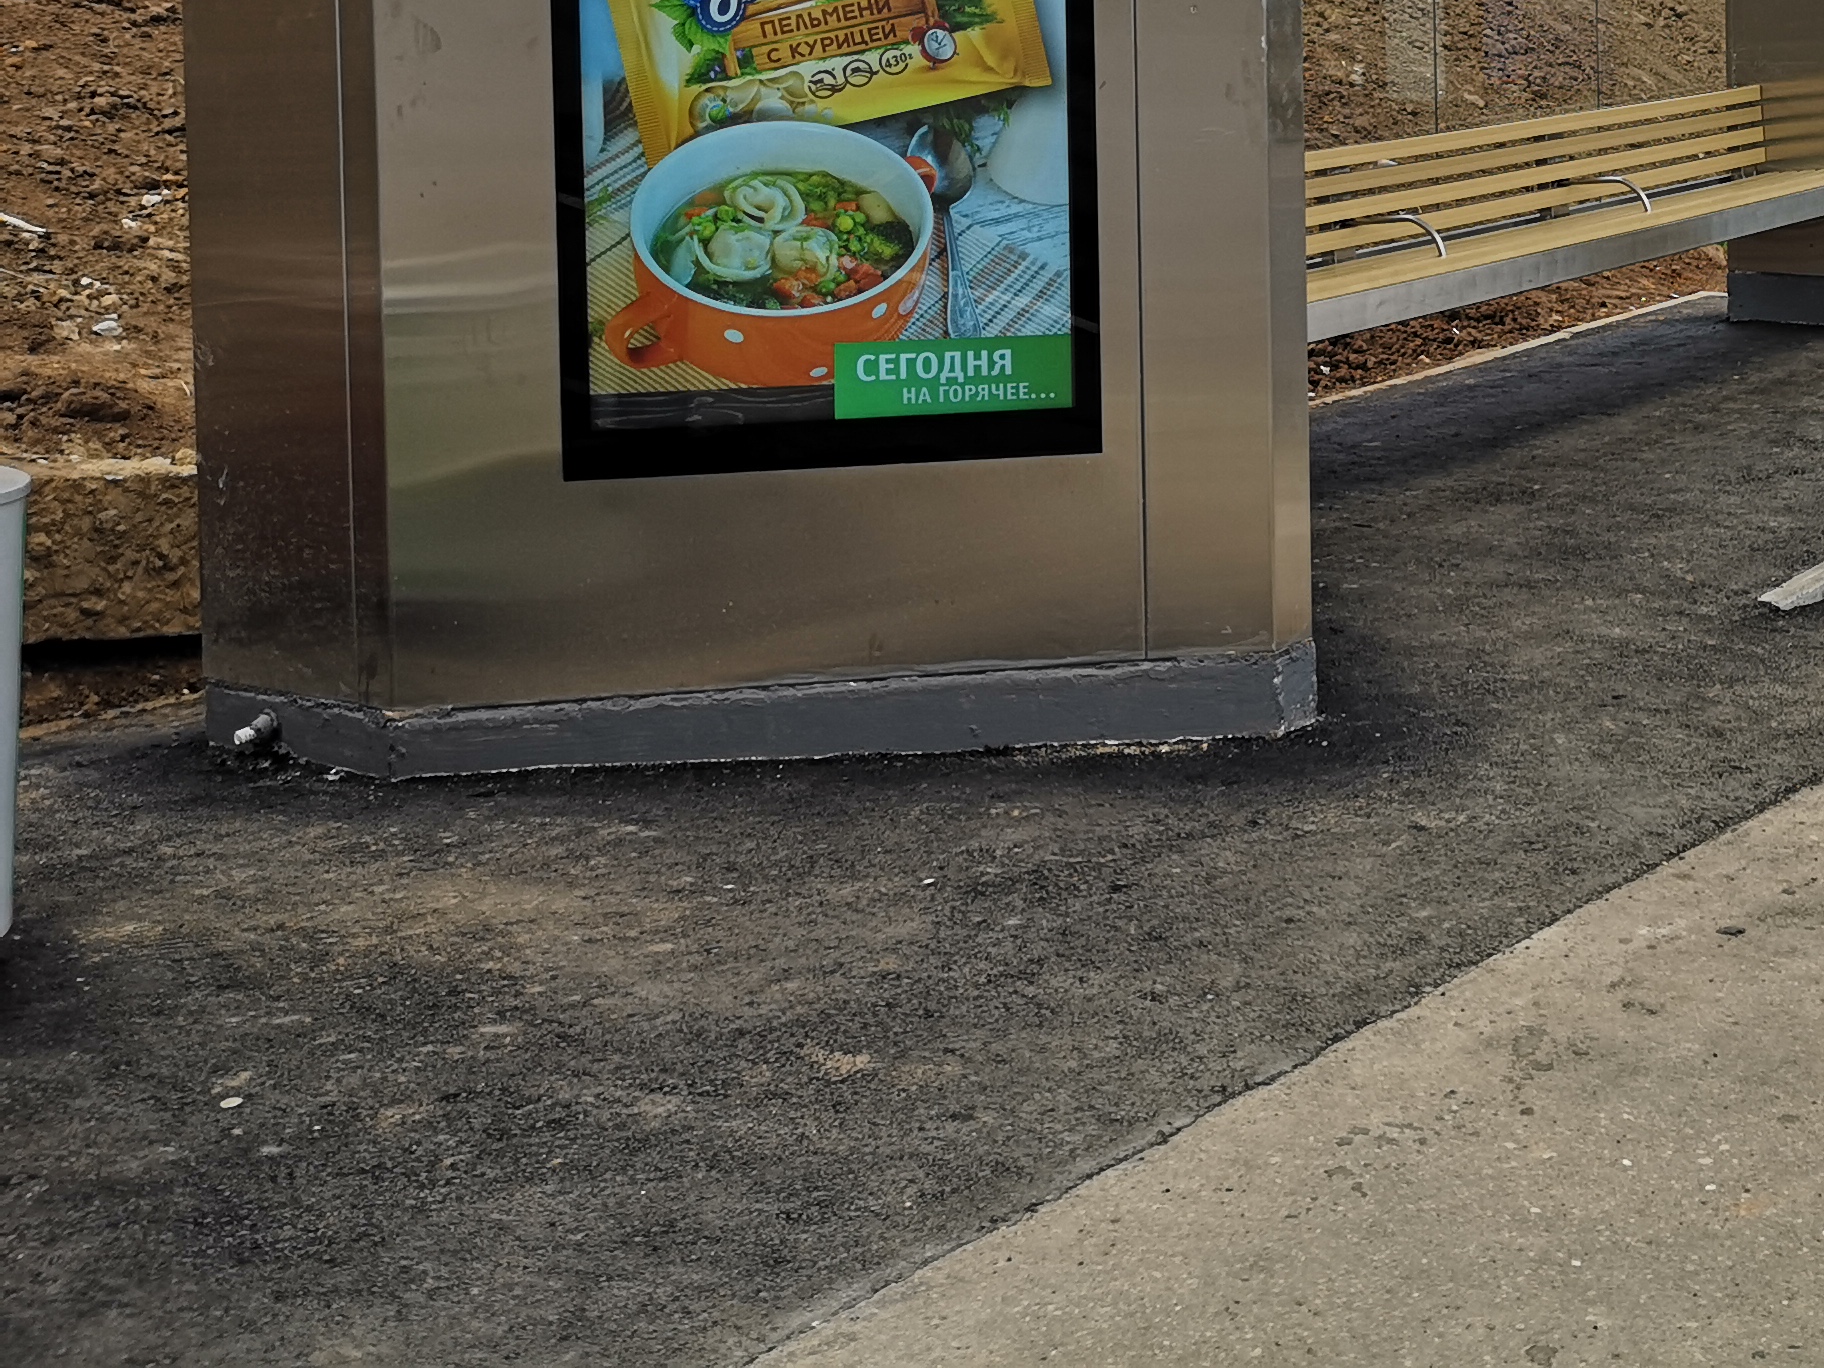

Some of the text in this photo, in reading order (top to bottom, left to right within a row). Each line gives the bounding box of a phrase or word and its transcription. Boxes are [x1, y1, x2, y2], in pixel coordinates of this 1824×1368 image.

[789, 20, 898, 60] КУРИЦЕЙ
[855, 348, 1013, 384] СЕГОДНЯ
[902, 382, 1056, 404] НА ГОРЯЧЕЕ...
